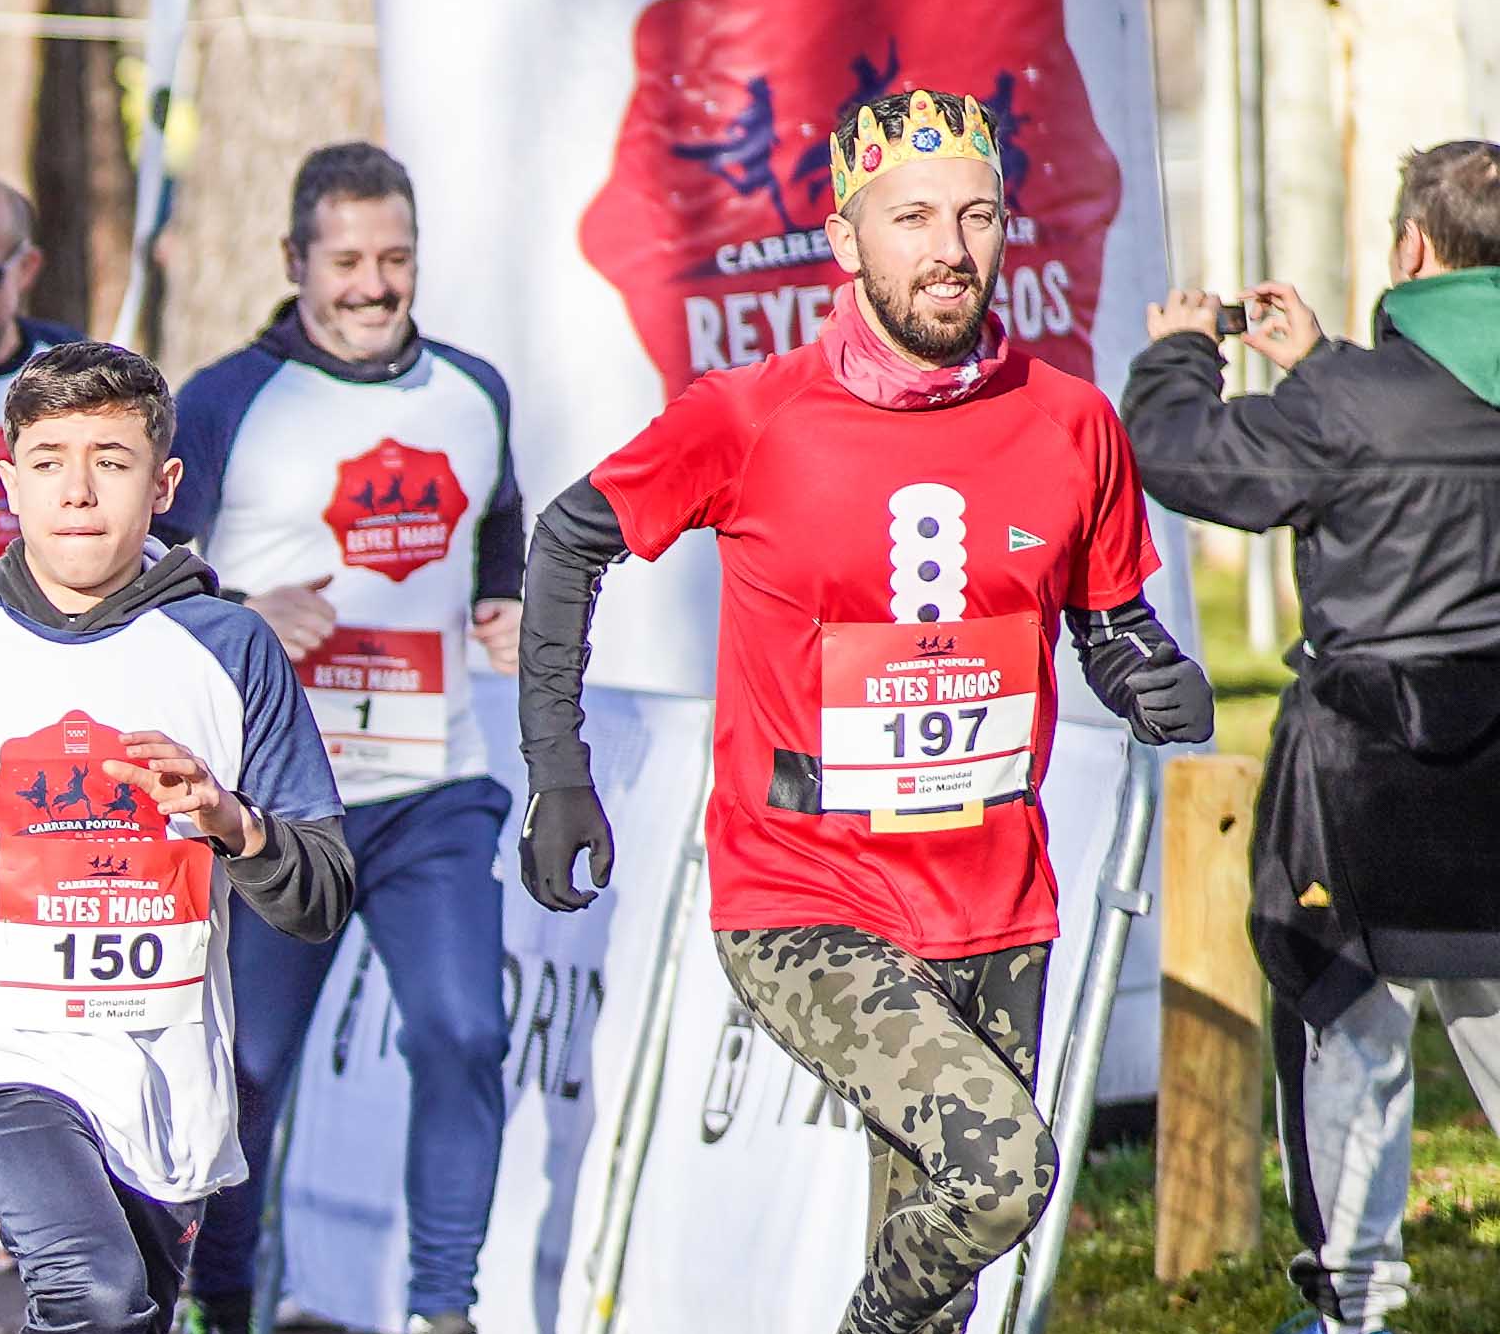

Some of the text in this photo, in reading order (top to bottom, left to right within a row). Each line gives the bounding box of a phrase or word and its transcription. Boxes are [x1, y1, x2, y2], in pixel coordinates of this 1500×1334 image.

[715, 227, 832, 274] CARRE
[685, 282, 843, 373] REYE
[886, 657, 986, 672] CARRERA POPULAR
[866, 670, 1002, 703] REYES MAGOS
[355, 696, 372, 731] 1
[884, 707, 988, 758] 197
[918, 771, 973, 783] Comunidad
[918, 780, 972, 794] de Madrid
[28, 819, 141, 834] CARRERA POPULAR
[57, 879, 160, 891] CARRERA POPULAR
[36, 894, 176, 924] REYES MAGOS
[54, 933, 163, 981] 150
[88, 998, 146, 1008] Comunidad
[88, 1008, 146, 1018] de Madrid
